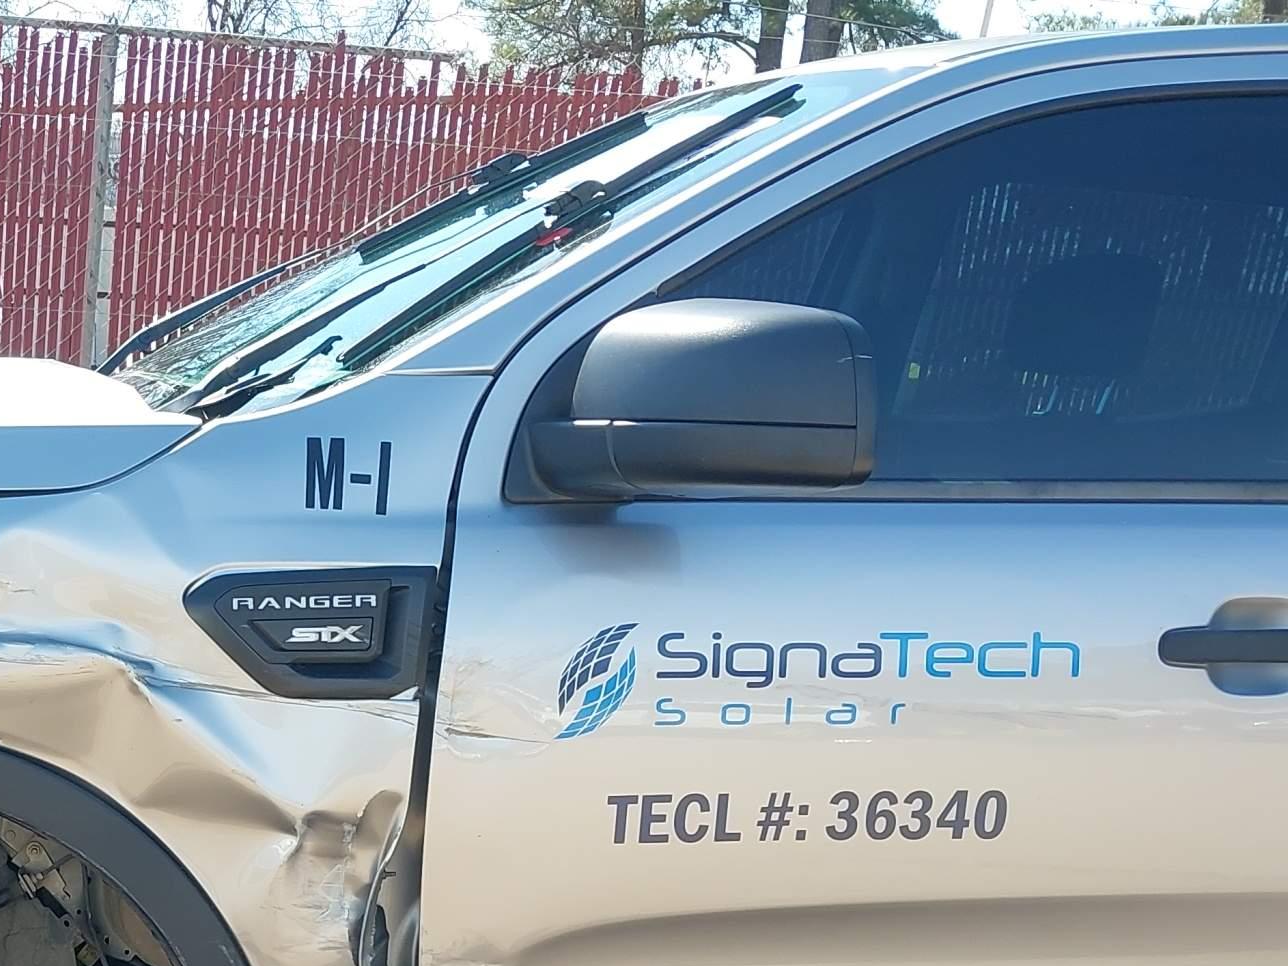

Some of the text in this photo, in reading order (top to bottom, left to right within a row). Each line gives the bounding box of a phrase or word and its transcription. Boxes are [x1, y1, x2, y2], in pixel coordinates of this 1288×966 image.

[232, 594, 377, 611] RANGER
[285, 625, 364, 643] STX
[656, 632, 1081, 688] SignaTech
[654, 697, 906, 725] Solar
[607, 790, 1008, 844] TECL #: 36340
